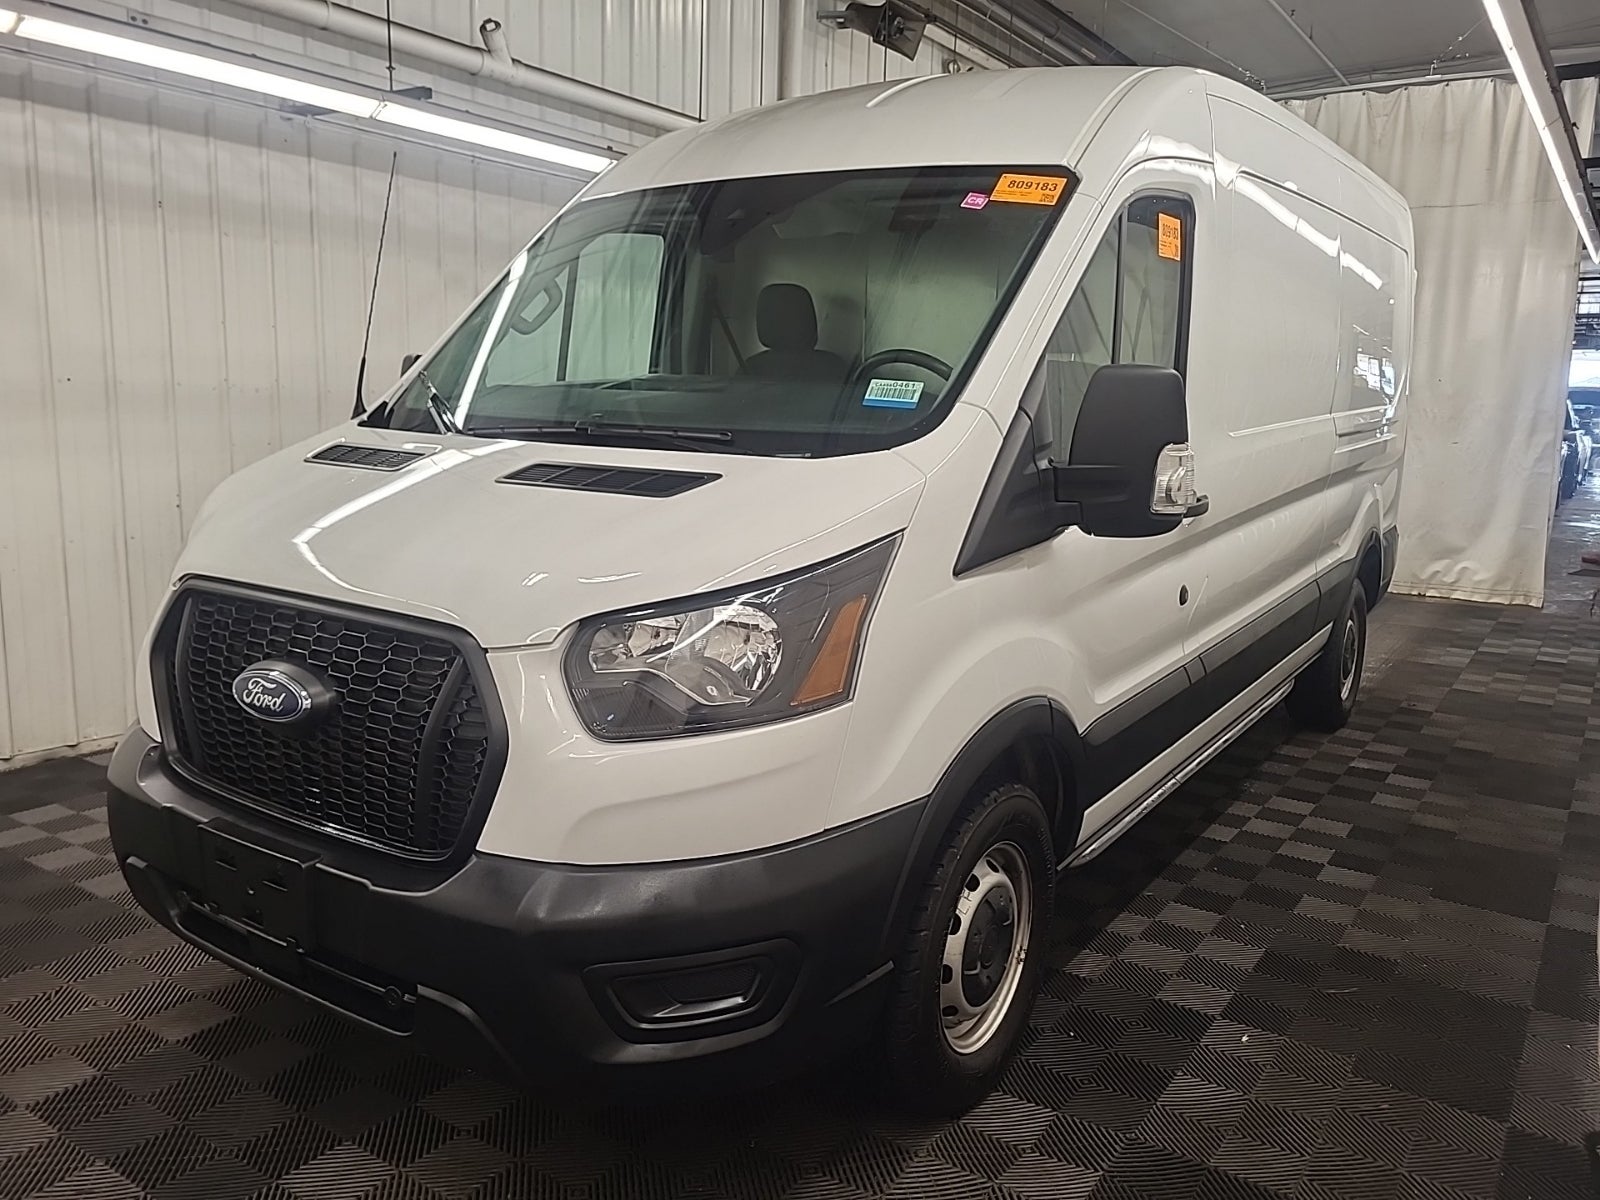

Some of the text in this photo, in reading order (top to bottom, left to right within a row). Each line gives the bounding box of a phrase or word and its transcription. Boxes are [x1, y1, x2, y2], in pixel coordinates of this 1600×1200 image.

[1007, 179, 1058, 192] 809183
[967, 196, 985, 206] CR
[243, 677, 286, 712] Ford
